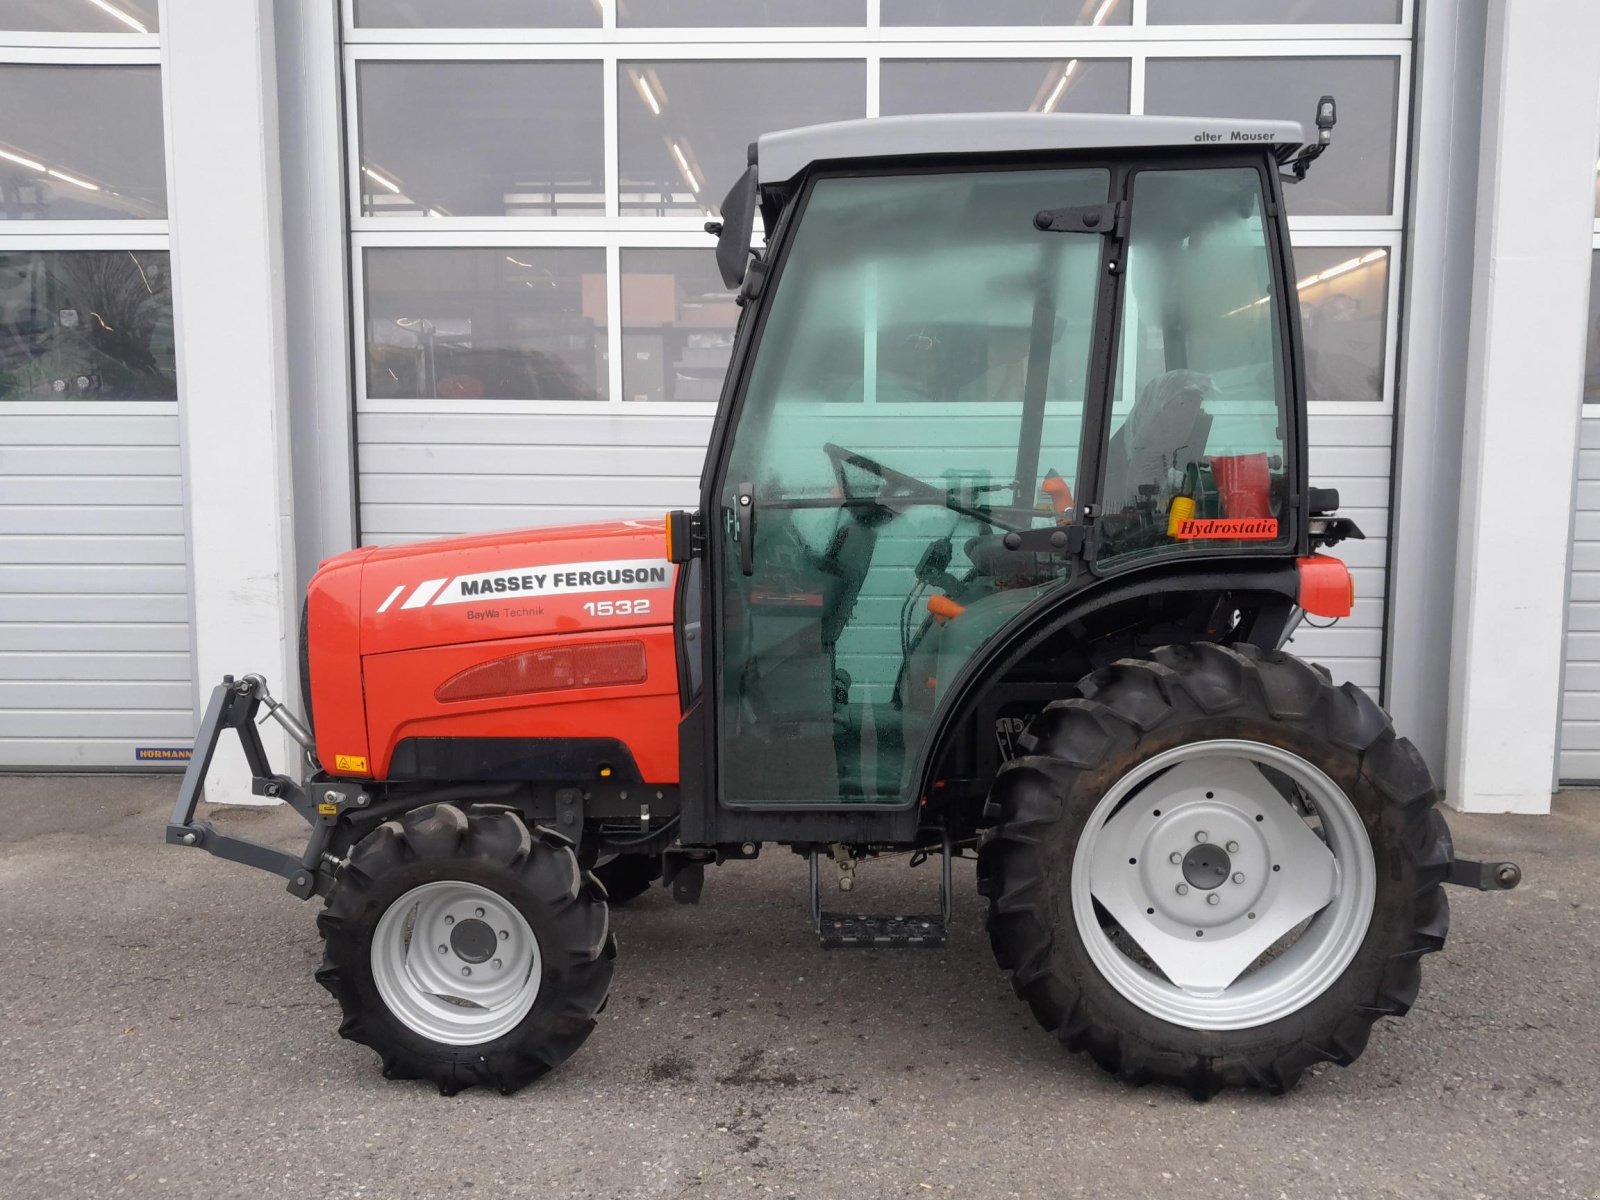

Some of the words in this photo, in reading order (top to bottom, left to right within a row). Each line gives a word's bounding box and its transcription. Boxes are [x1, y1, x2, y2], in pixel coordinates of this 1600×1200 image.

[1194, 131, 1222, 142] alter
[1230, 131, 1275, 141] Mauser
[1181, 520, 1276, 537] Hydrostatic
[460, 574, 547, 596] MASSEY
[553, 567, 665, 587] FERGUSON
[467, 608, 500, 620] BayWa
[504, 606, 544, 617] Technik
[583, 599, 650, 616] 1532
